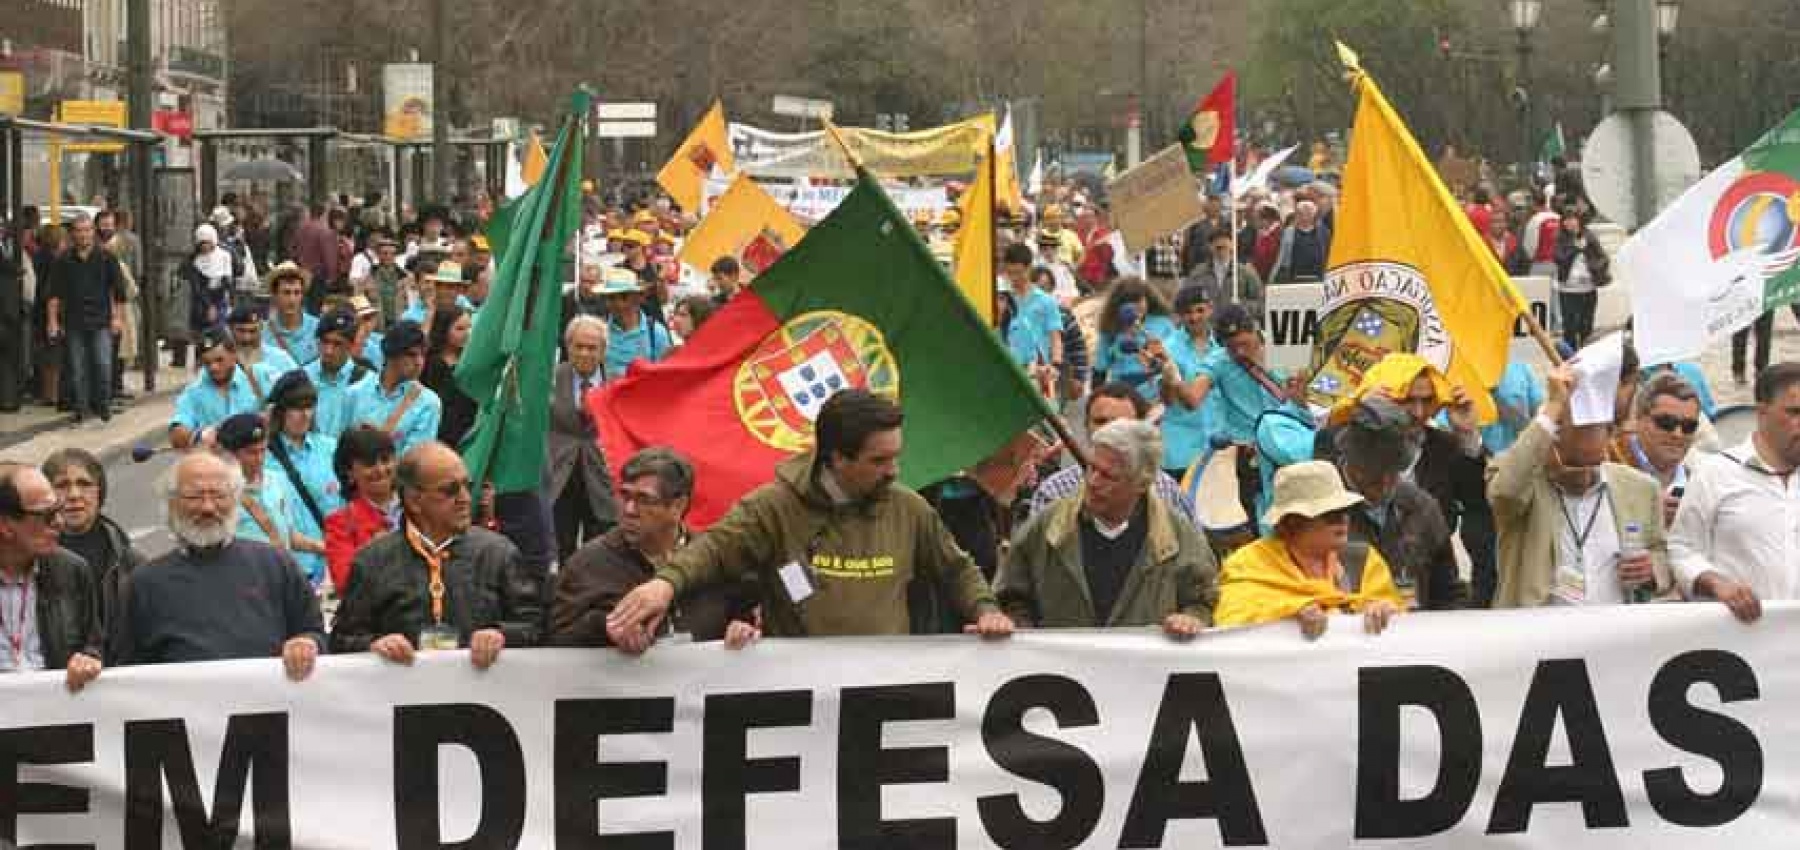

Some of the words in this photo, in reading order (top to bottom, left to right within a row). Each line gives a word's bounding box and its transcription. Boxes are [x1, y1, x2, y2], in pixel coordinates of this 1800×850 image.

[0, 710, 292, 850] EM
[394, 672, 1268, 850] DEFESA
[1354, 649, 1763, 839] DAS
